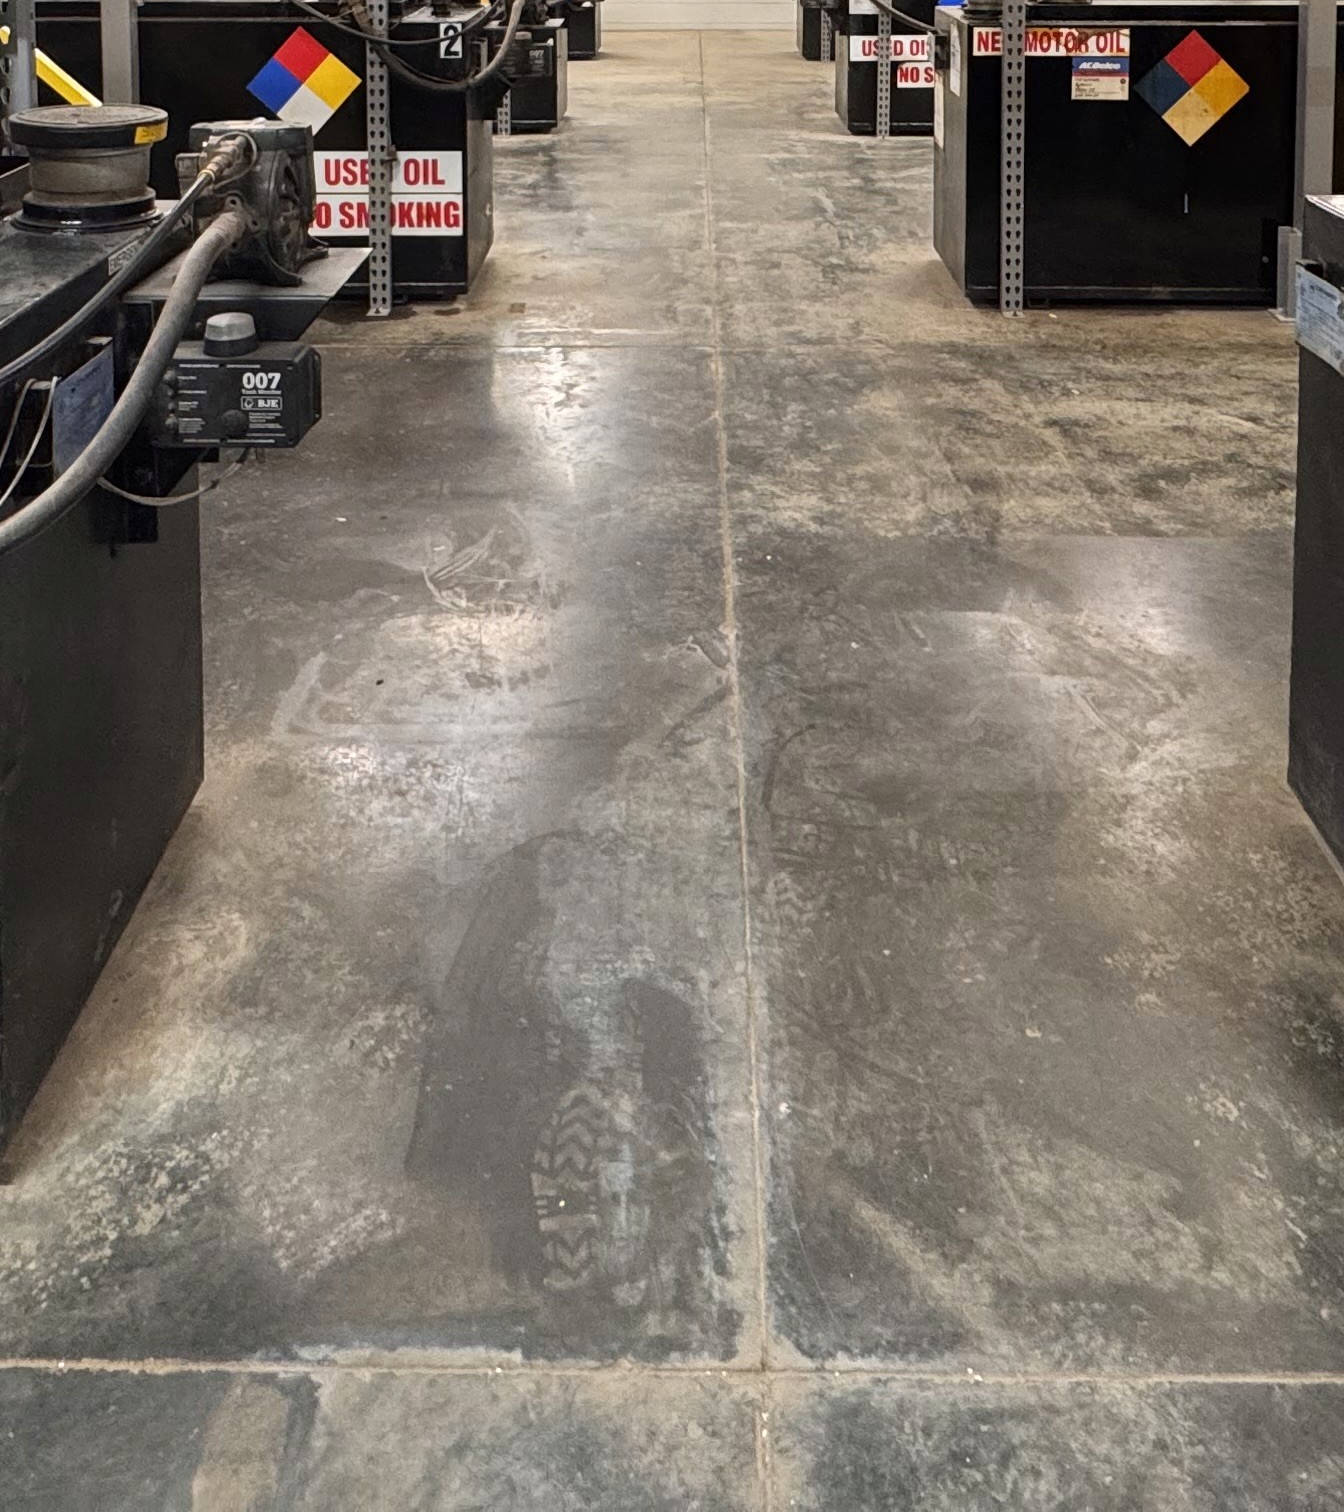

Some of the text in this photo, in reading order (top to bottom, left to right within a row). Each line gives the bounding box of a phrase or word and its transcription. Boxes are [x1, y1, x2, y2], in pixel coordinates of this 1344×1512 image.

[443, 25, 461, 57] 2
[861, 40, 928, 57] USD OI
[977, 31, 1126, 53] NE MOTOR OIL
[899, 67, 920, 83] NO
[324, 158, 446, 186] USE OIL
[309, 201, 332, 229] O
[242, 372, 282, 390] 007
